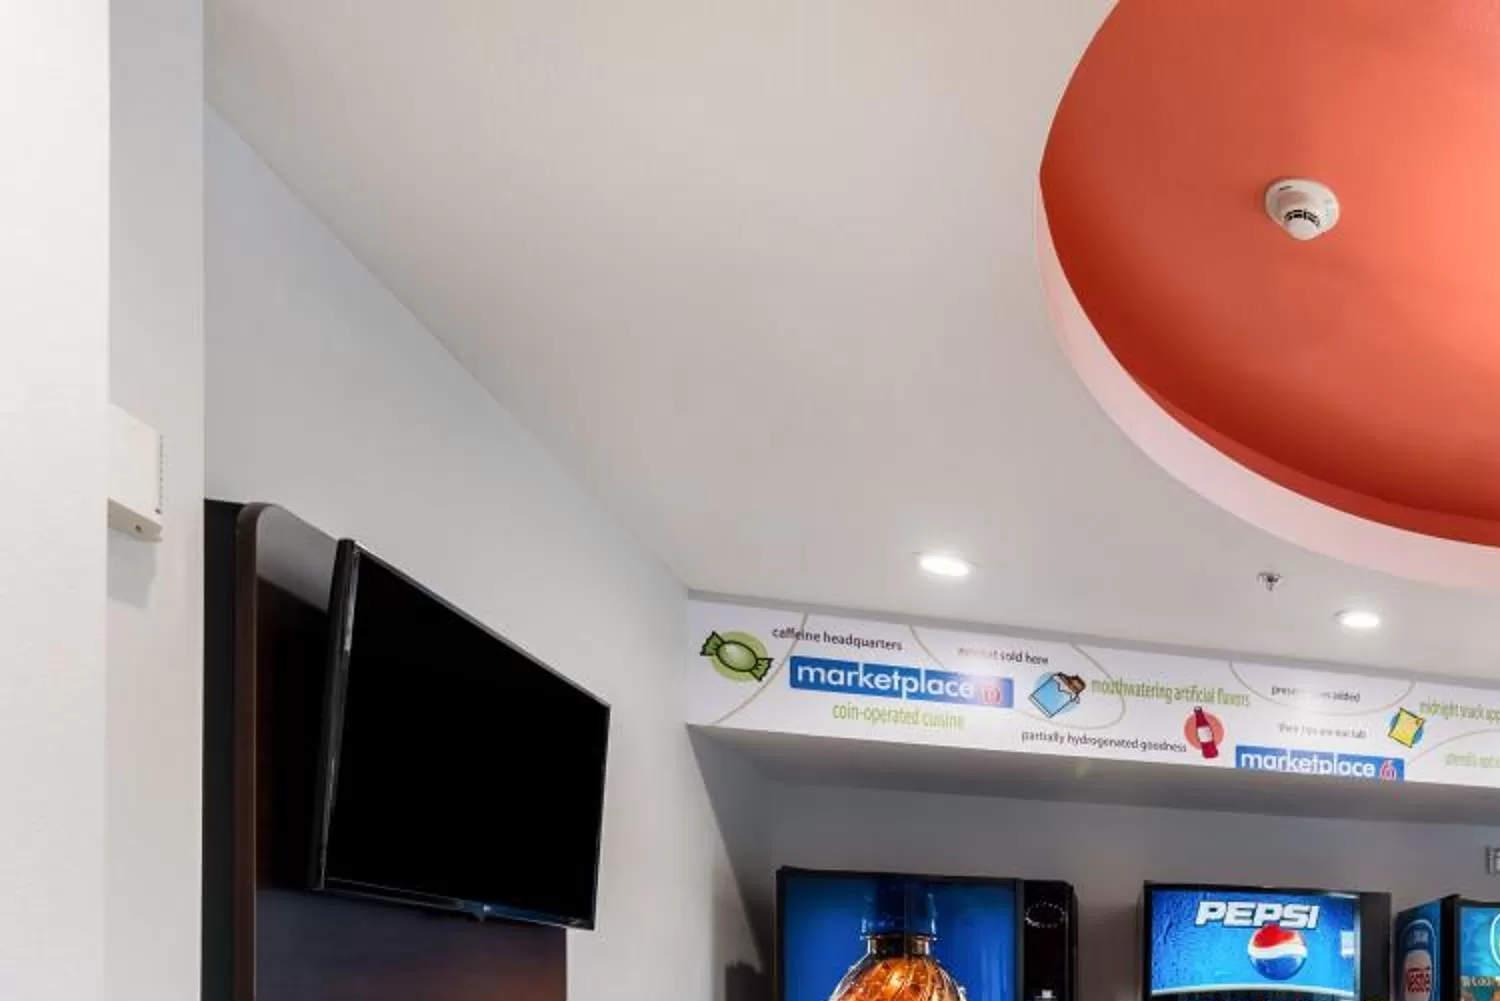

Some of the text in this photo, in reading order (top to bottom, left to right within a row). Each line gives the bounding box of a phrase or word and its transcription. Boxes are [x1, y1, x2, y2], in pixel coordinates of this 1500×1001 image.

[771, 625, 903, 652] caffeine headquarters
[796, 660, 975, 702] marketplace
[831, 700, 921, 727] coin-operated
[1020, 728, 1187, 753] partially hydrogenated goodness
[1240, 747, 1375, 777] marketplace
[1195, 900, 1322, 930] PEPSI
